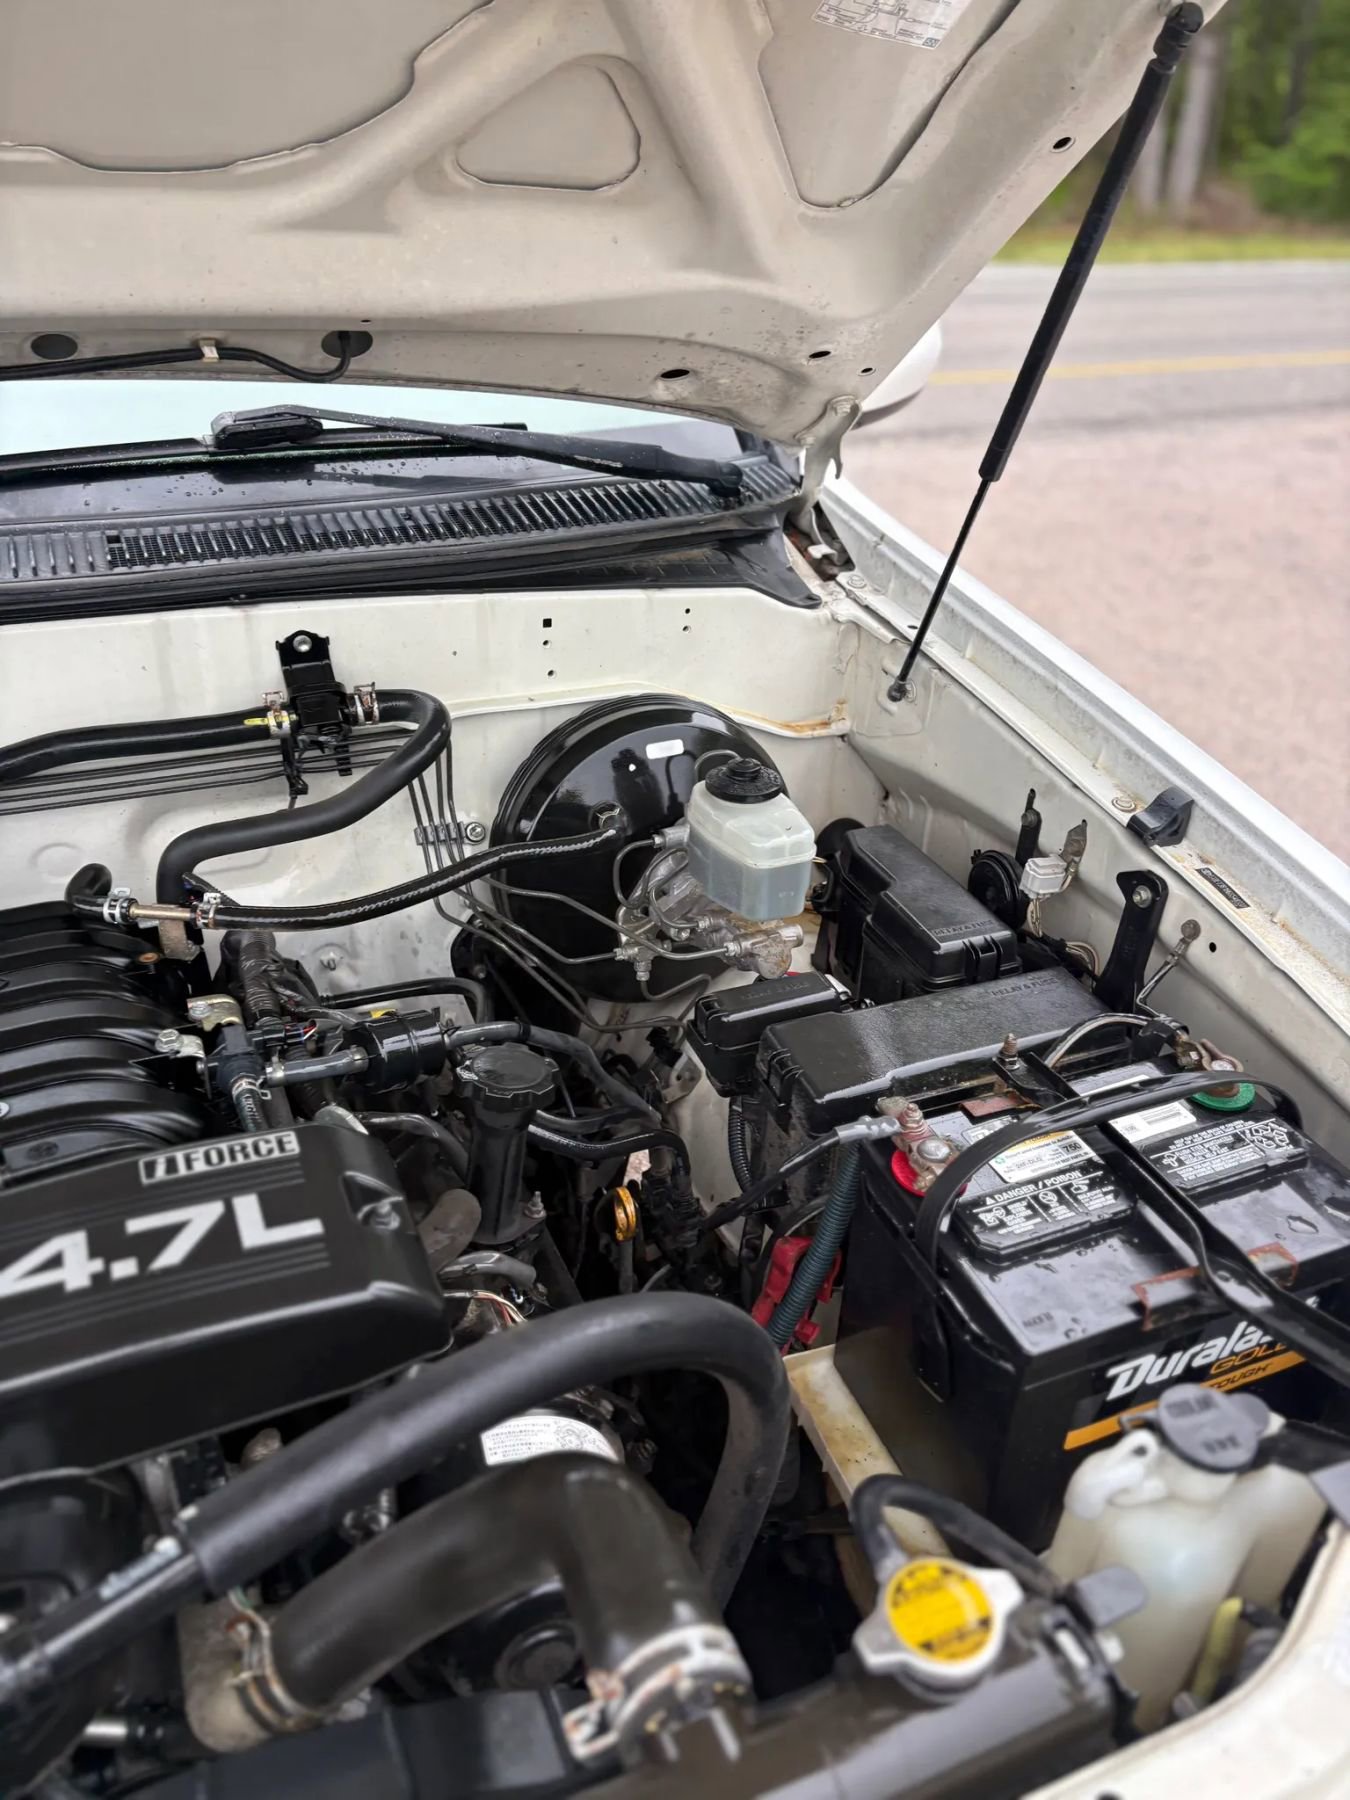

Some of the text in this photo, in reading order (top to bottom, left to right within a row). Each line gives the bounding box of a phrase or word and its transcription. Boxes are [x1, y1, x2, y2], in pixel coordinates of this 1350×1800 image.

[1064, 1142, 1083, 1155] 750
[995, 1183, 1038, 1202] DANGER
[1044, 1170, 1083, 1187] POISON
[0, 1193, 324, 1297] 4.7L
[1106, 1321, 1274, 1400] Durala
